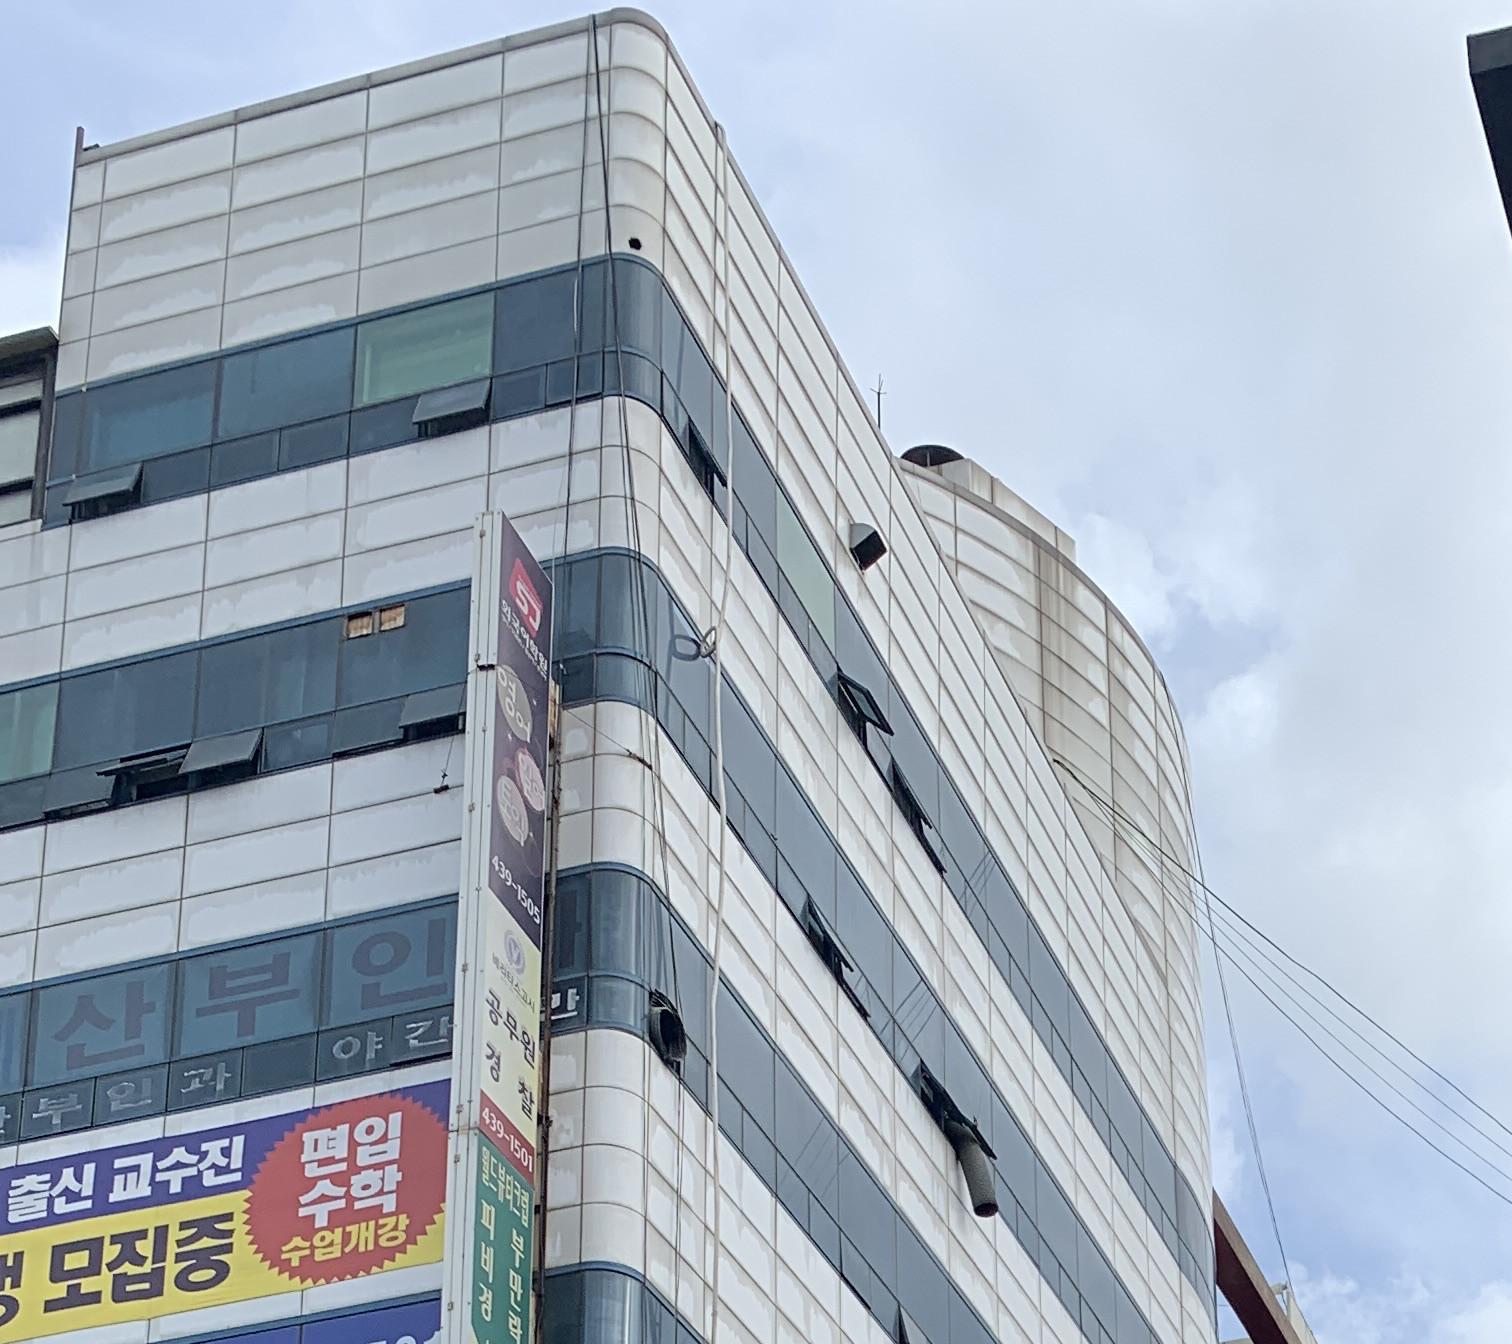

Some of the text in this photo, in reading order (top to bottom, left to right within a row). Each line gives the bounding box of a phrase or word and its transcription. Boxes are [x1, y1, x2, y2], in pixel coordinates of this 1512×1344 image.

[50, 915, 455, 1073] 산부인
[0, 1060, 232, 1137] 부인과
[6, 1135, 246, 1223] 출신 교수진
[299, 1110, 404, 1173] 편입
[297, 1165, 404, 1229] 수학
[43, 1212, 236, 1314] 모집중
[279, 1216, 411, 1267] 수업개강
